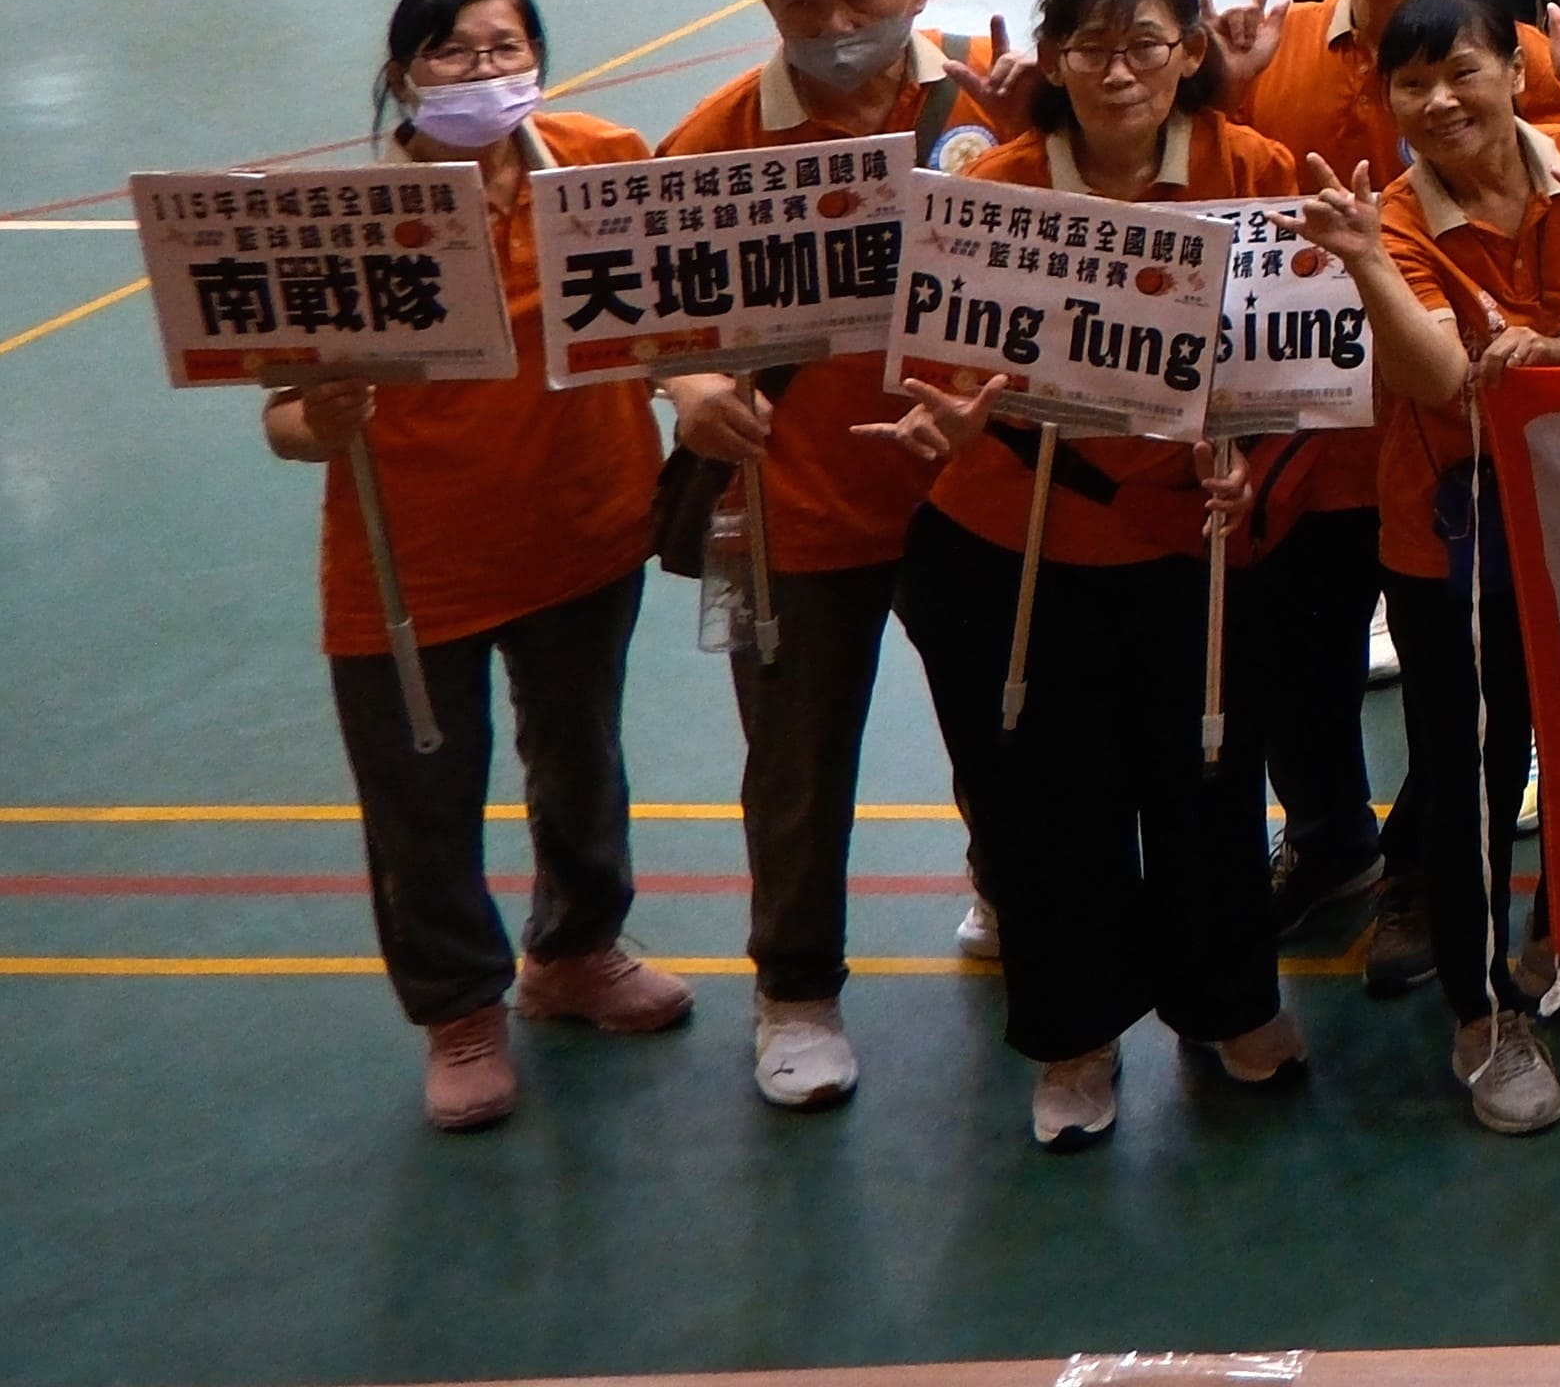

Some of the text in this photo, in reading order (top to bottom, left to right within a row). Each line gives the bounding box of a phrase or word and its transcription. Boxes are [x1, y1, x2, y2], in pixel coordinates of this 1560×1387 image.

[152, 182, 458, 221] 115年府城盃全國聽障
[556, 149, 888, 215] 115年府城盃全國聽障
[234, 223, 387, 253] 籃球錦標賽
[643, 194, 808, 237] 籃球錦標賽
[924, 193, 1206, 267] 115年府城盃全國聽障
[190, 255, 448, 334] 南戰隊
[563, 220, 902, 333] 天地咖哩
[987, 240, 1128, 289] 籃球錦標賽
[903, 272, 1207, 391] Ping Tung
